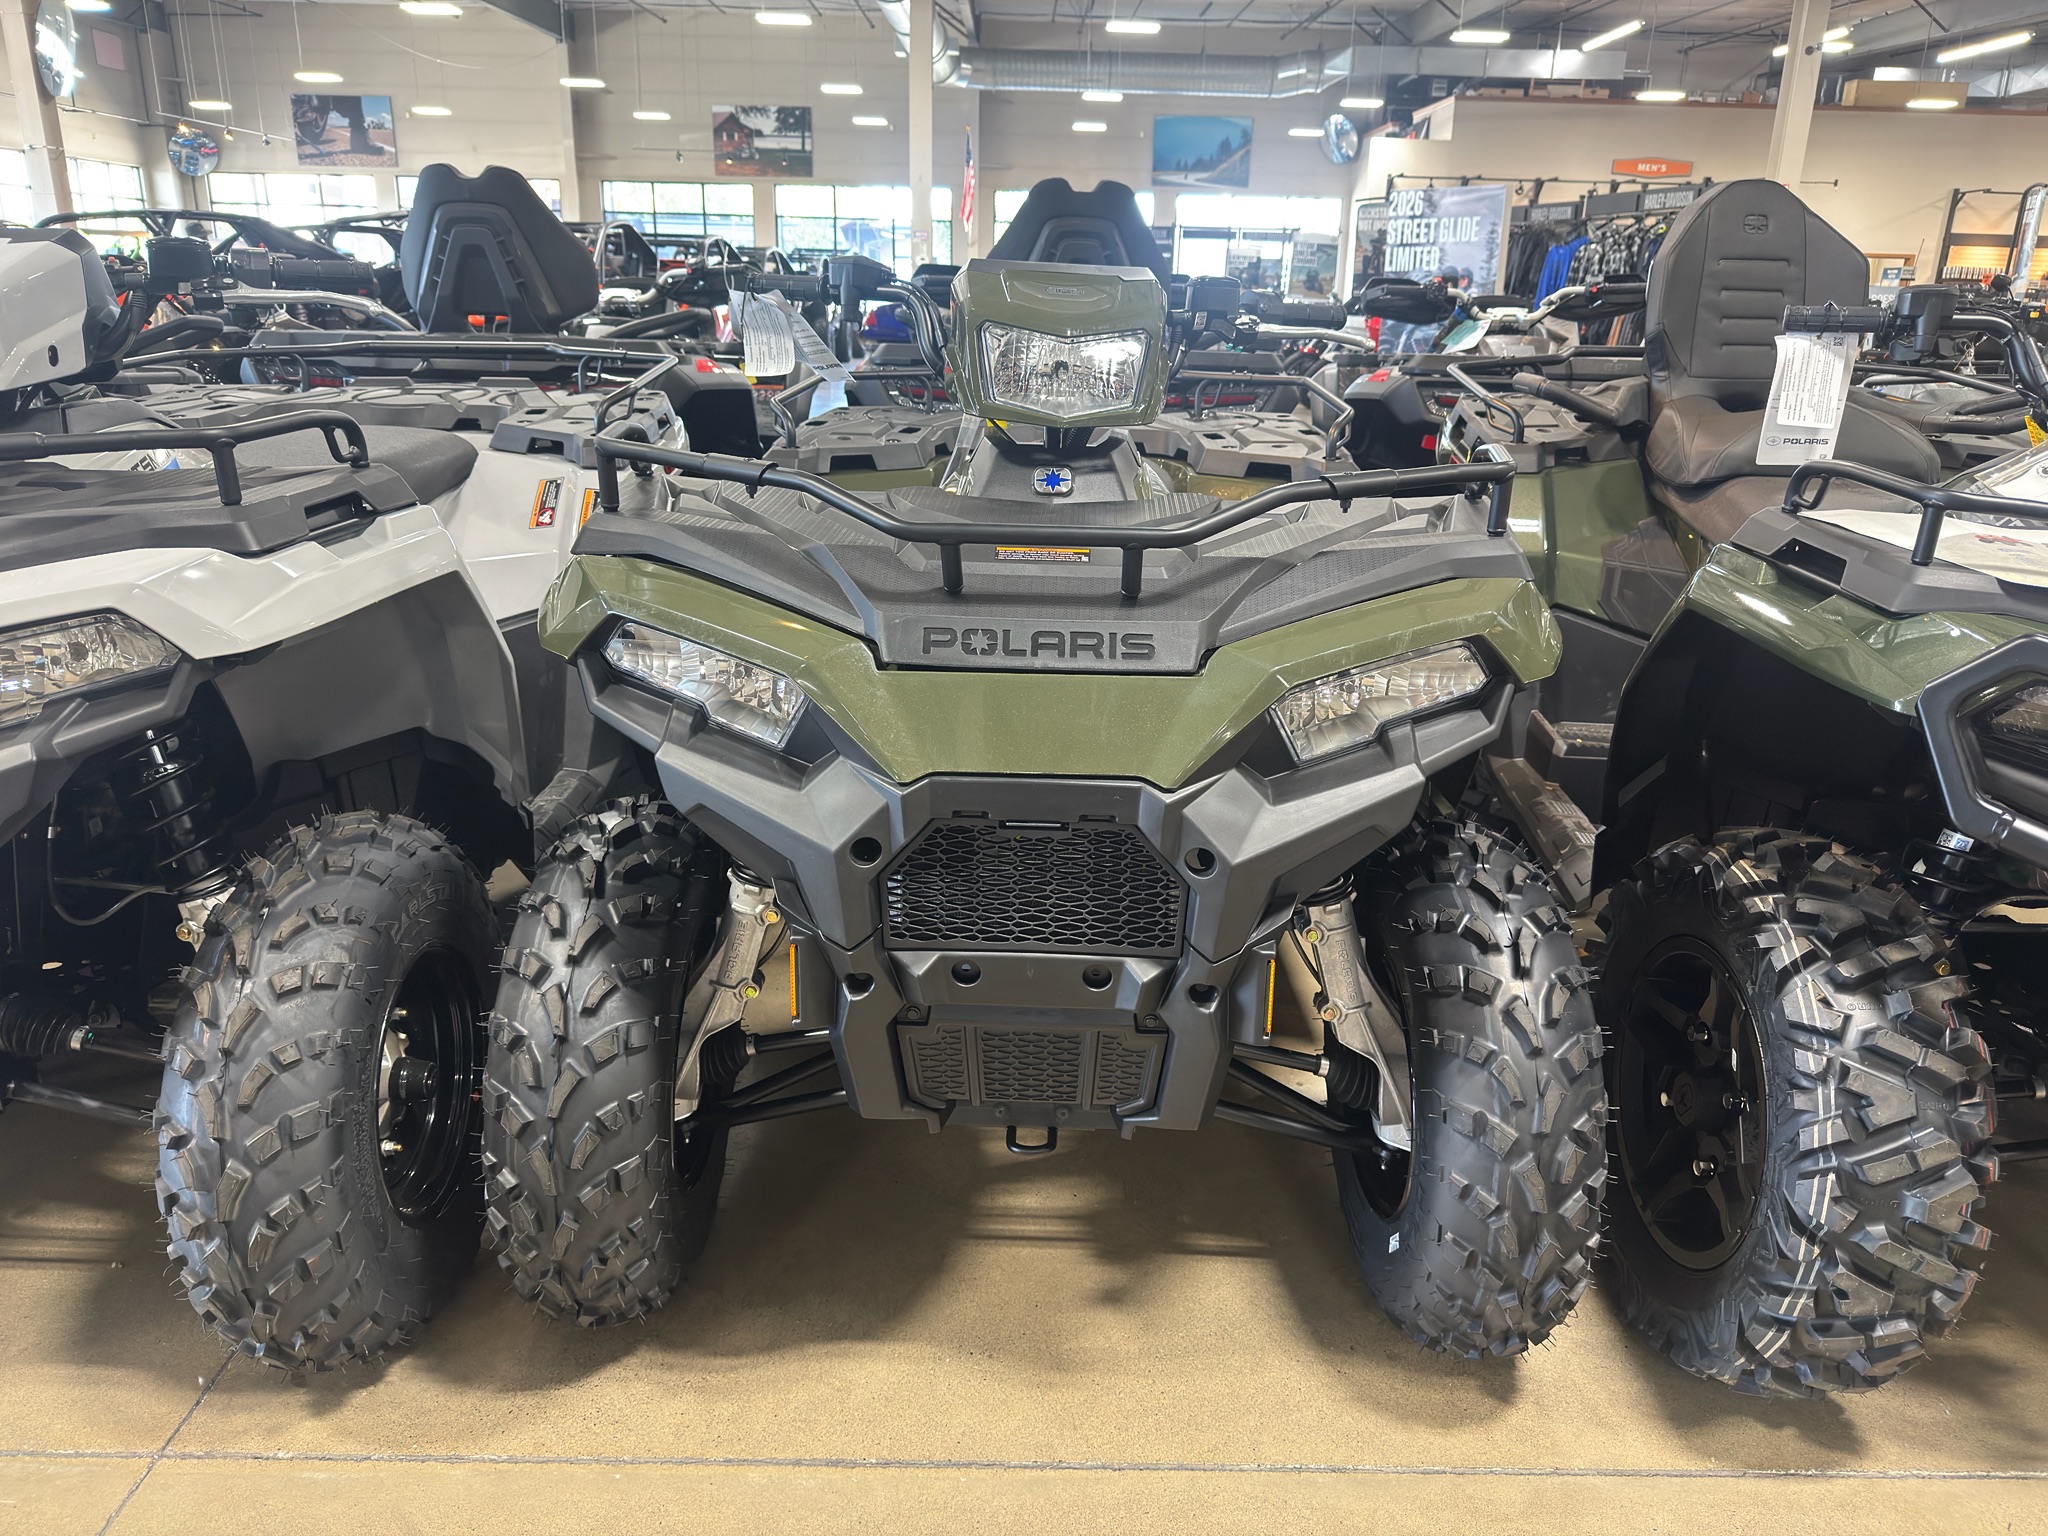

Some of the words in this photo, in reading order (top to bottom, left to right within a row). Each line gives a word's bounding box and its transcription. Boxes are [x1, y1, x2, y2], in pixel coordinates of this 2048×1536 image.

[1637, 163, 1667, 172] MEN'S
[1388, 190, 1424, 217] 2026
[1643, 190, 1694, 210] HARLEY-DAVIDSON
[1386, 217, 1438, 244] STREET
[1439, 216, 1481, 242] GLIDE
[1384, 245, 1440, 272] LIMITED
[921, 627, 1156, 660] POLARIS
[724, 920, 748, 979] POLARIS
[1336, 940, 1358, 1001] POLARIS
